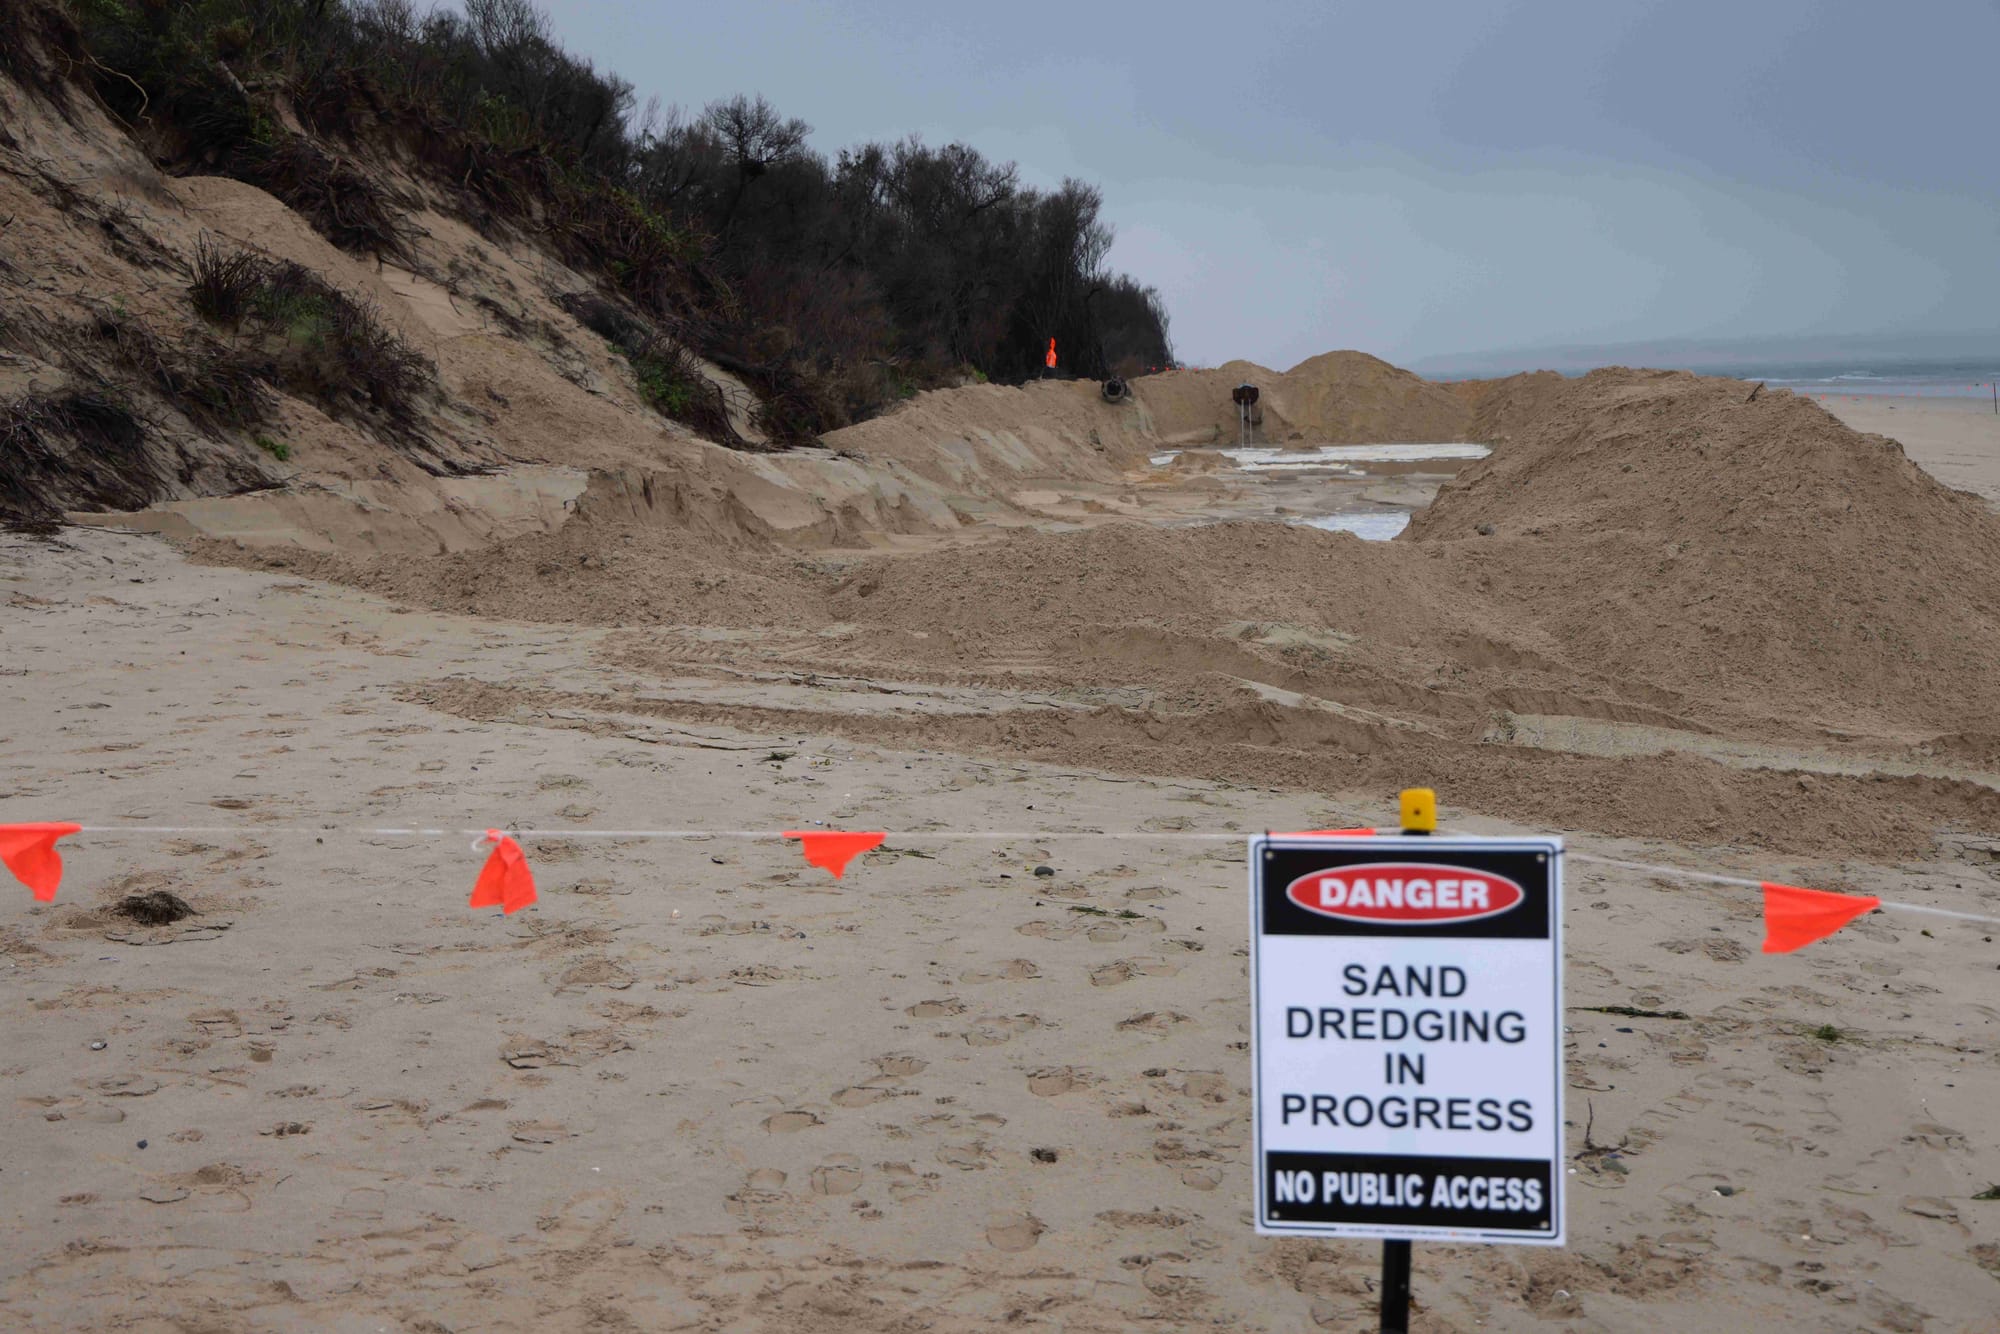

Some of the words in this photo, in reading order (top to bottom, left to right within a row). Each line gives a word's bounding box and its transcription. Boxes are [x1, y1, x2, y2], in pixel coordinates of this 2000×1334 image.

[1318, 877, 1490, 910] DANGER
[1341, 964, 1467, 998] SAND
[1286, 1007, 1526, 1043] DREDGING
[1385, 1053, 1426, 1085] IN
[1282, 1094, 1533, 1132] PROGRESS
[1274, 1170, 1316, 1203] NO
[1322, 1172, 1425, 1207] PUBLIC
[1431, 1176, 1543, 1212] ACCESS
